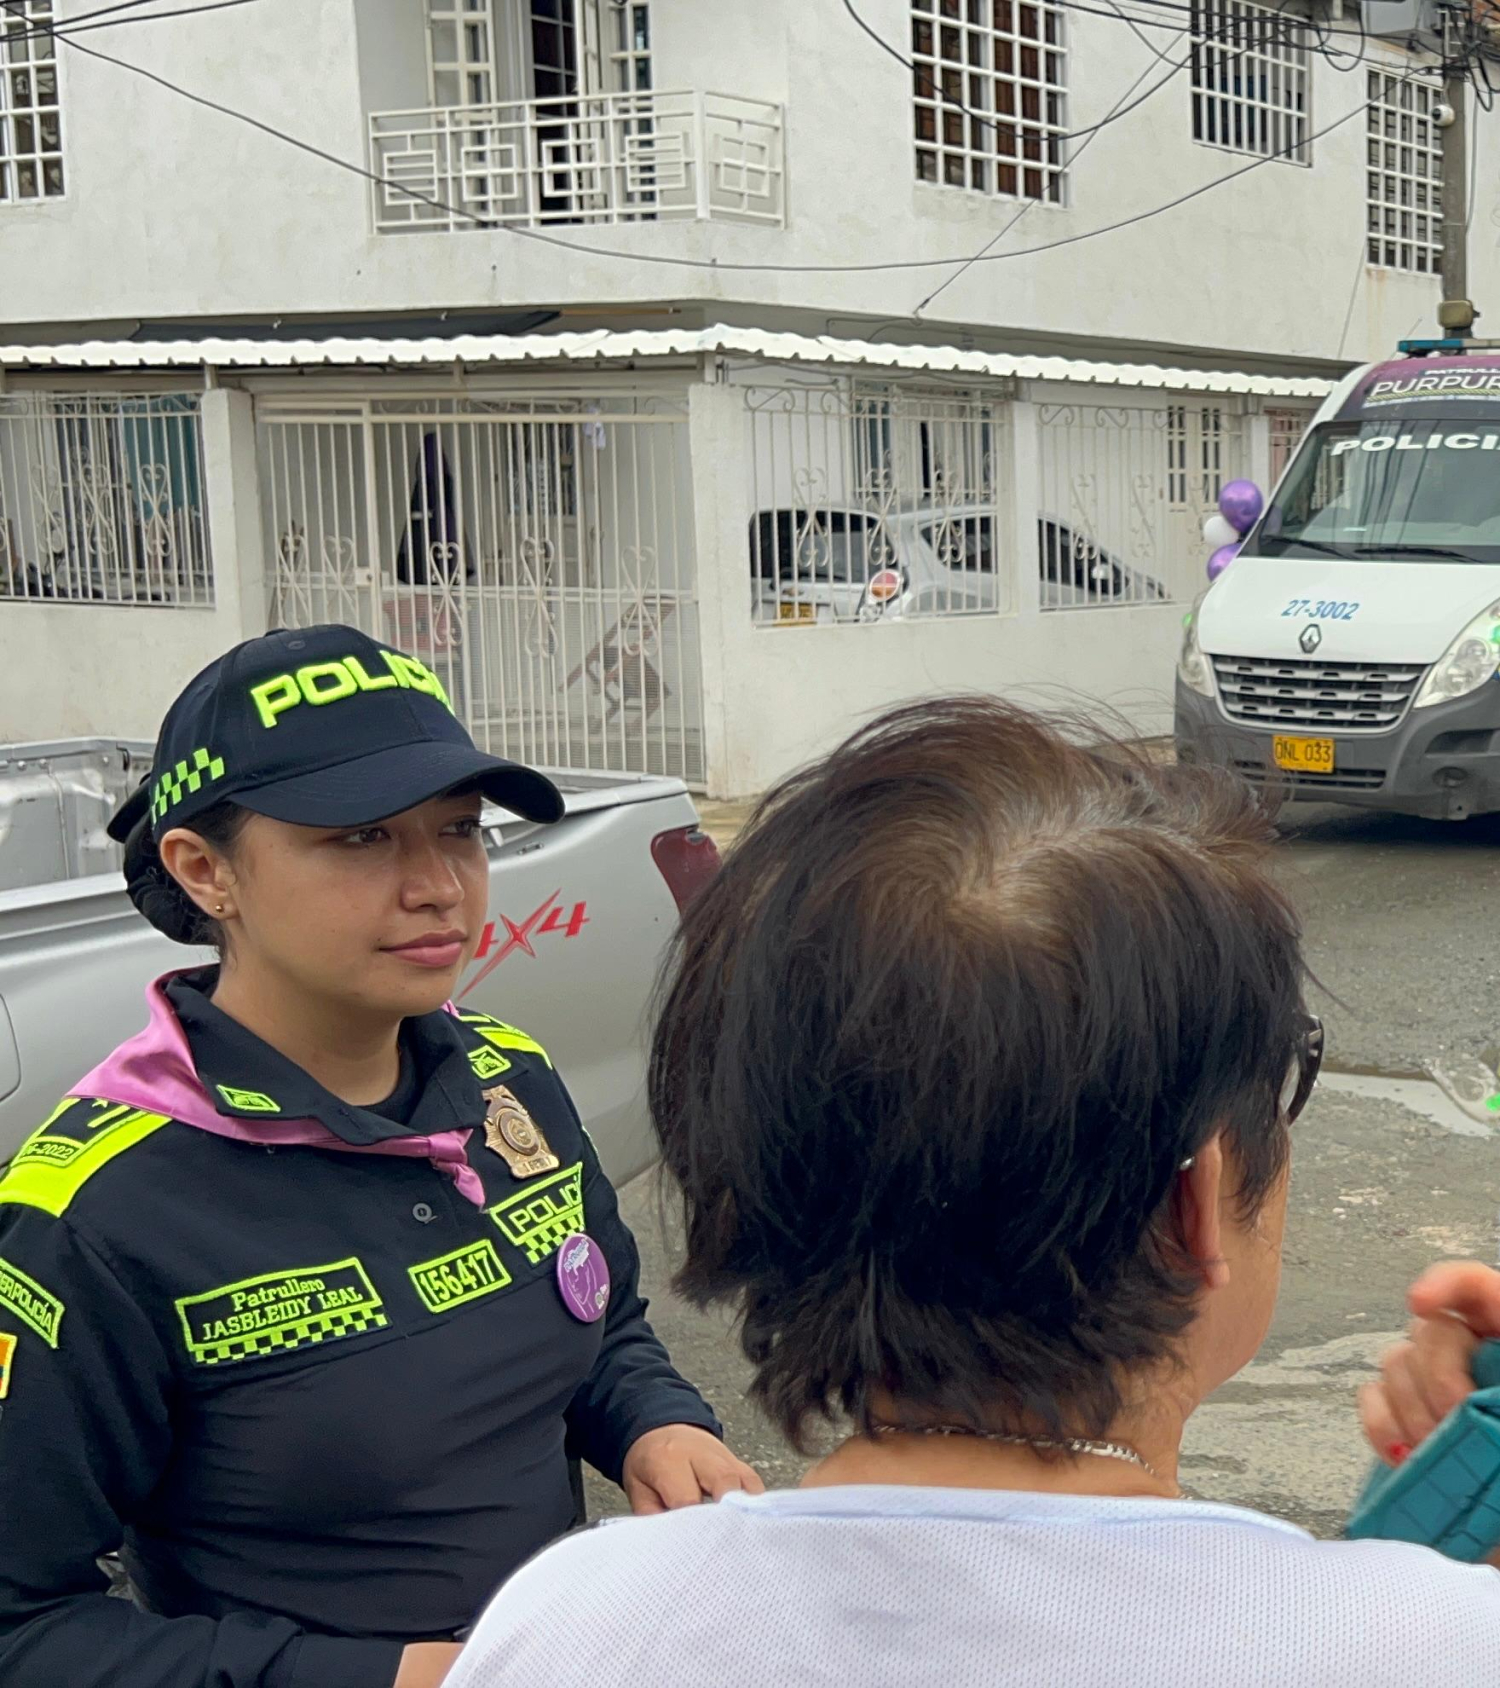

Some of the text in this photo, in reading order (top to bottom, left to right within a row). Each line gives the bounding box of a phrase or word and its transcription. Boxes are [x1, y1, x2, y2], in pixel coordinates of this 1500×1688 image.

[1281, 599, 1359, 620] 27-3002
[1305, 743, 1331, 763] 033
[419, 1250, 495, 1304] 156417
[231, 1278, 326, 1312] Patrullero
[202, 1287, 363, 1341] JASBLEIDY LEAL
